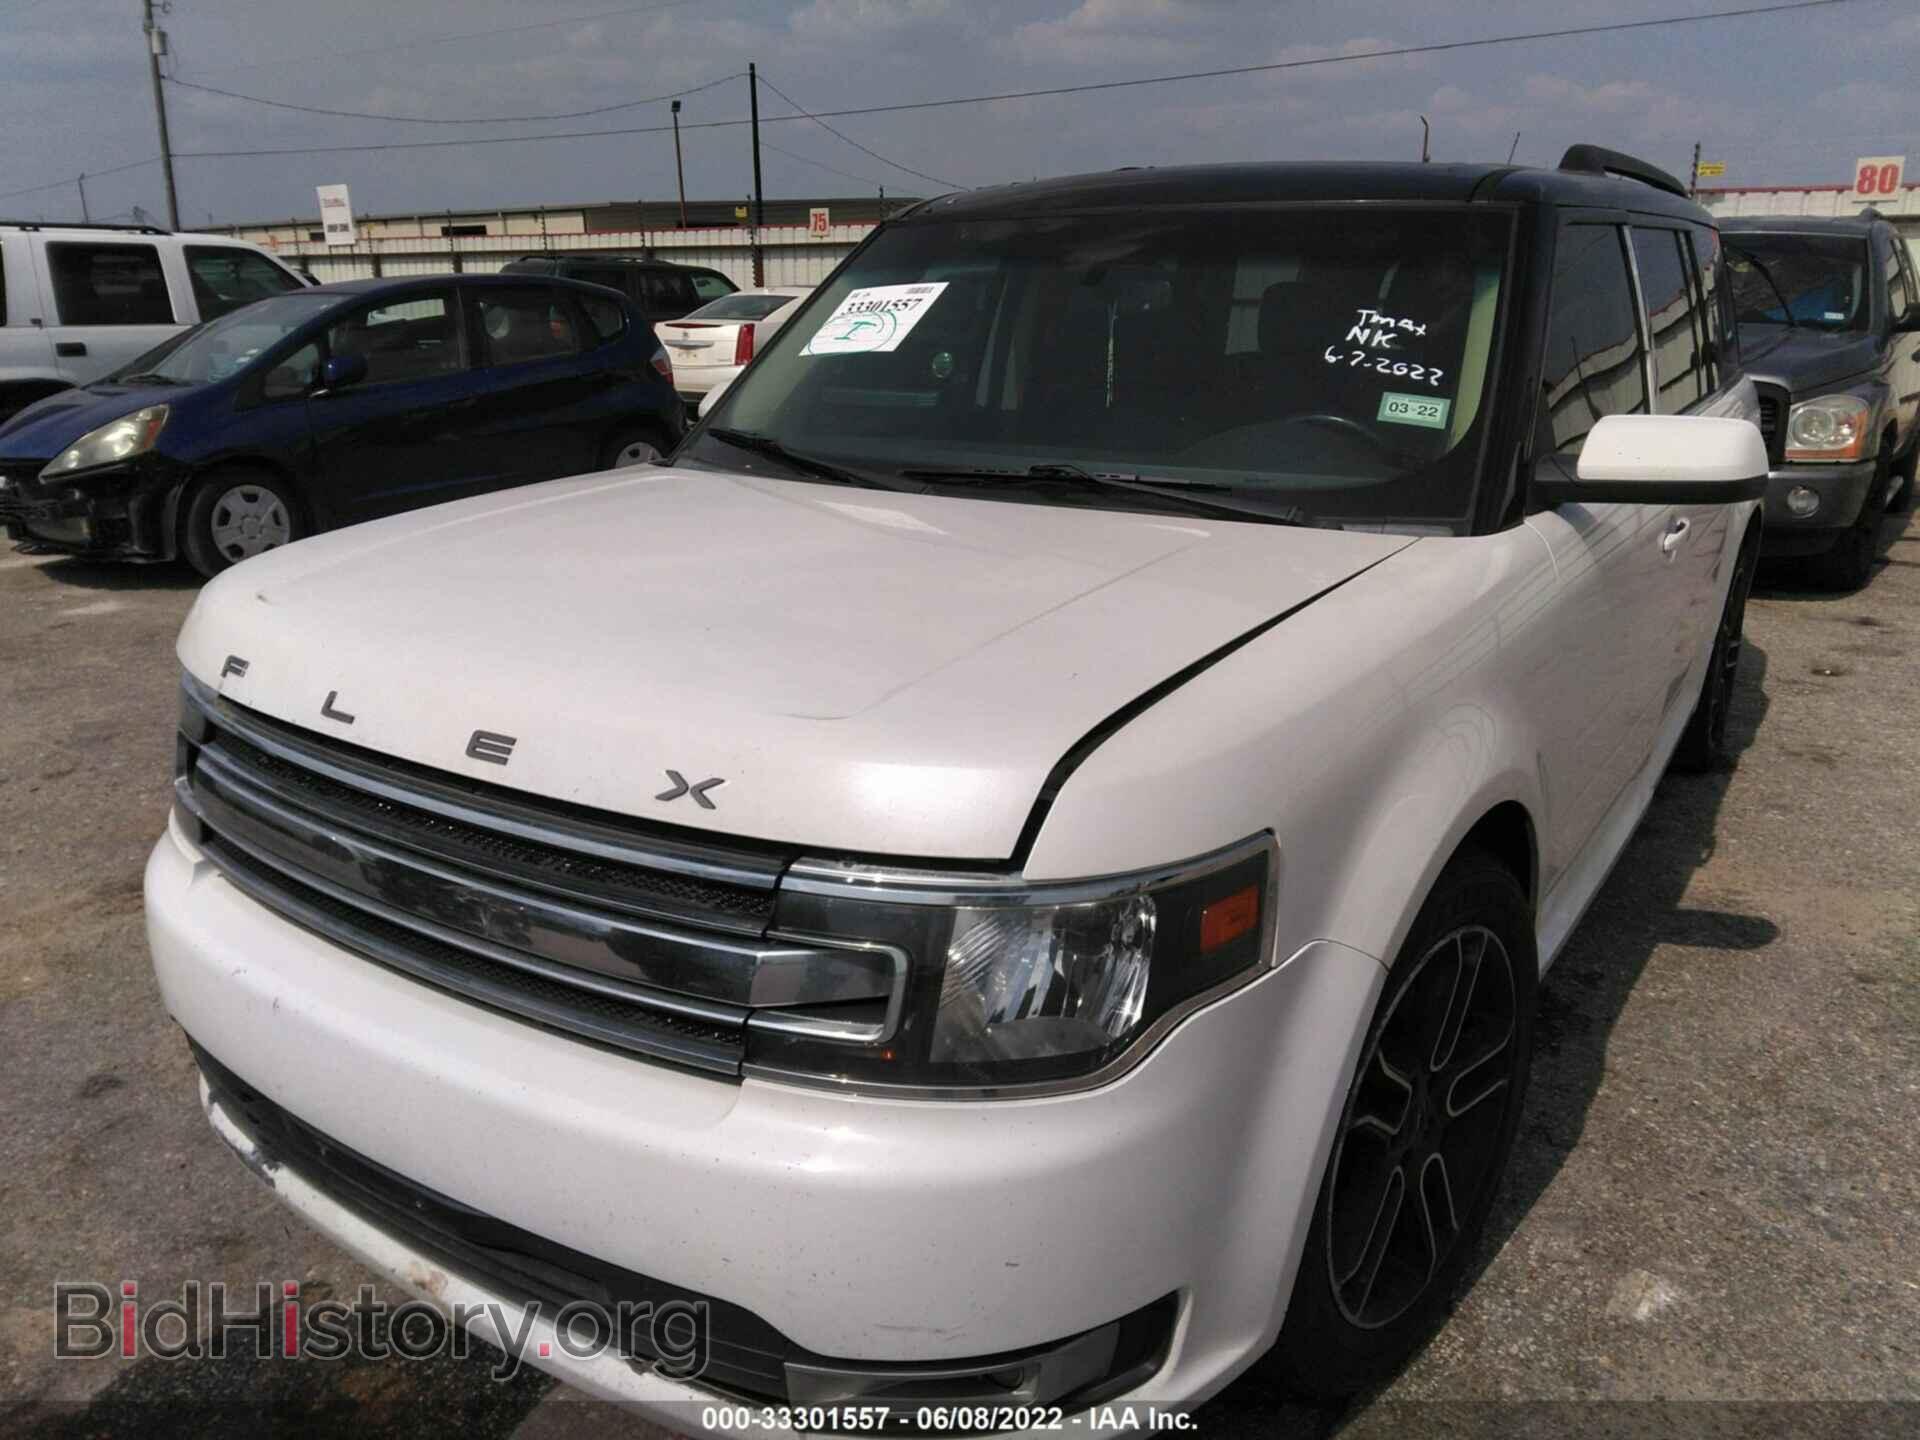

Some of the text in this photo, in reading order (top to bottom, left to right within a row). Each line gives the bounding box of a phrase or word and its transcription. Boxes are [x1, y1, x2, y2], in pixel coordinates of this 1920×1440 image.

[1856, 163, 1899, 194] 80
[811, 213, 826, 232] 75
[1345, 326, 1398, 348] NK
[220, 654, 726, 810] FLEX
